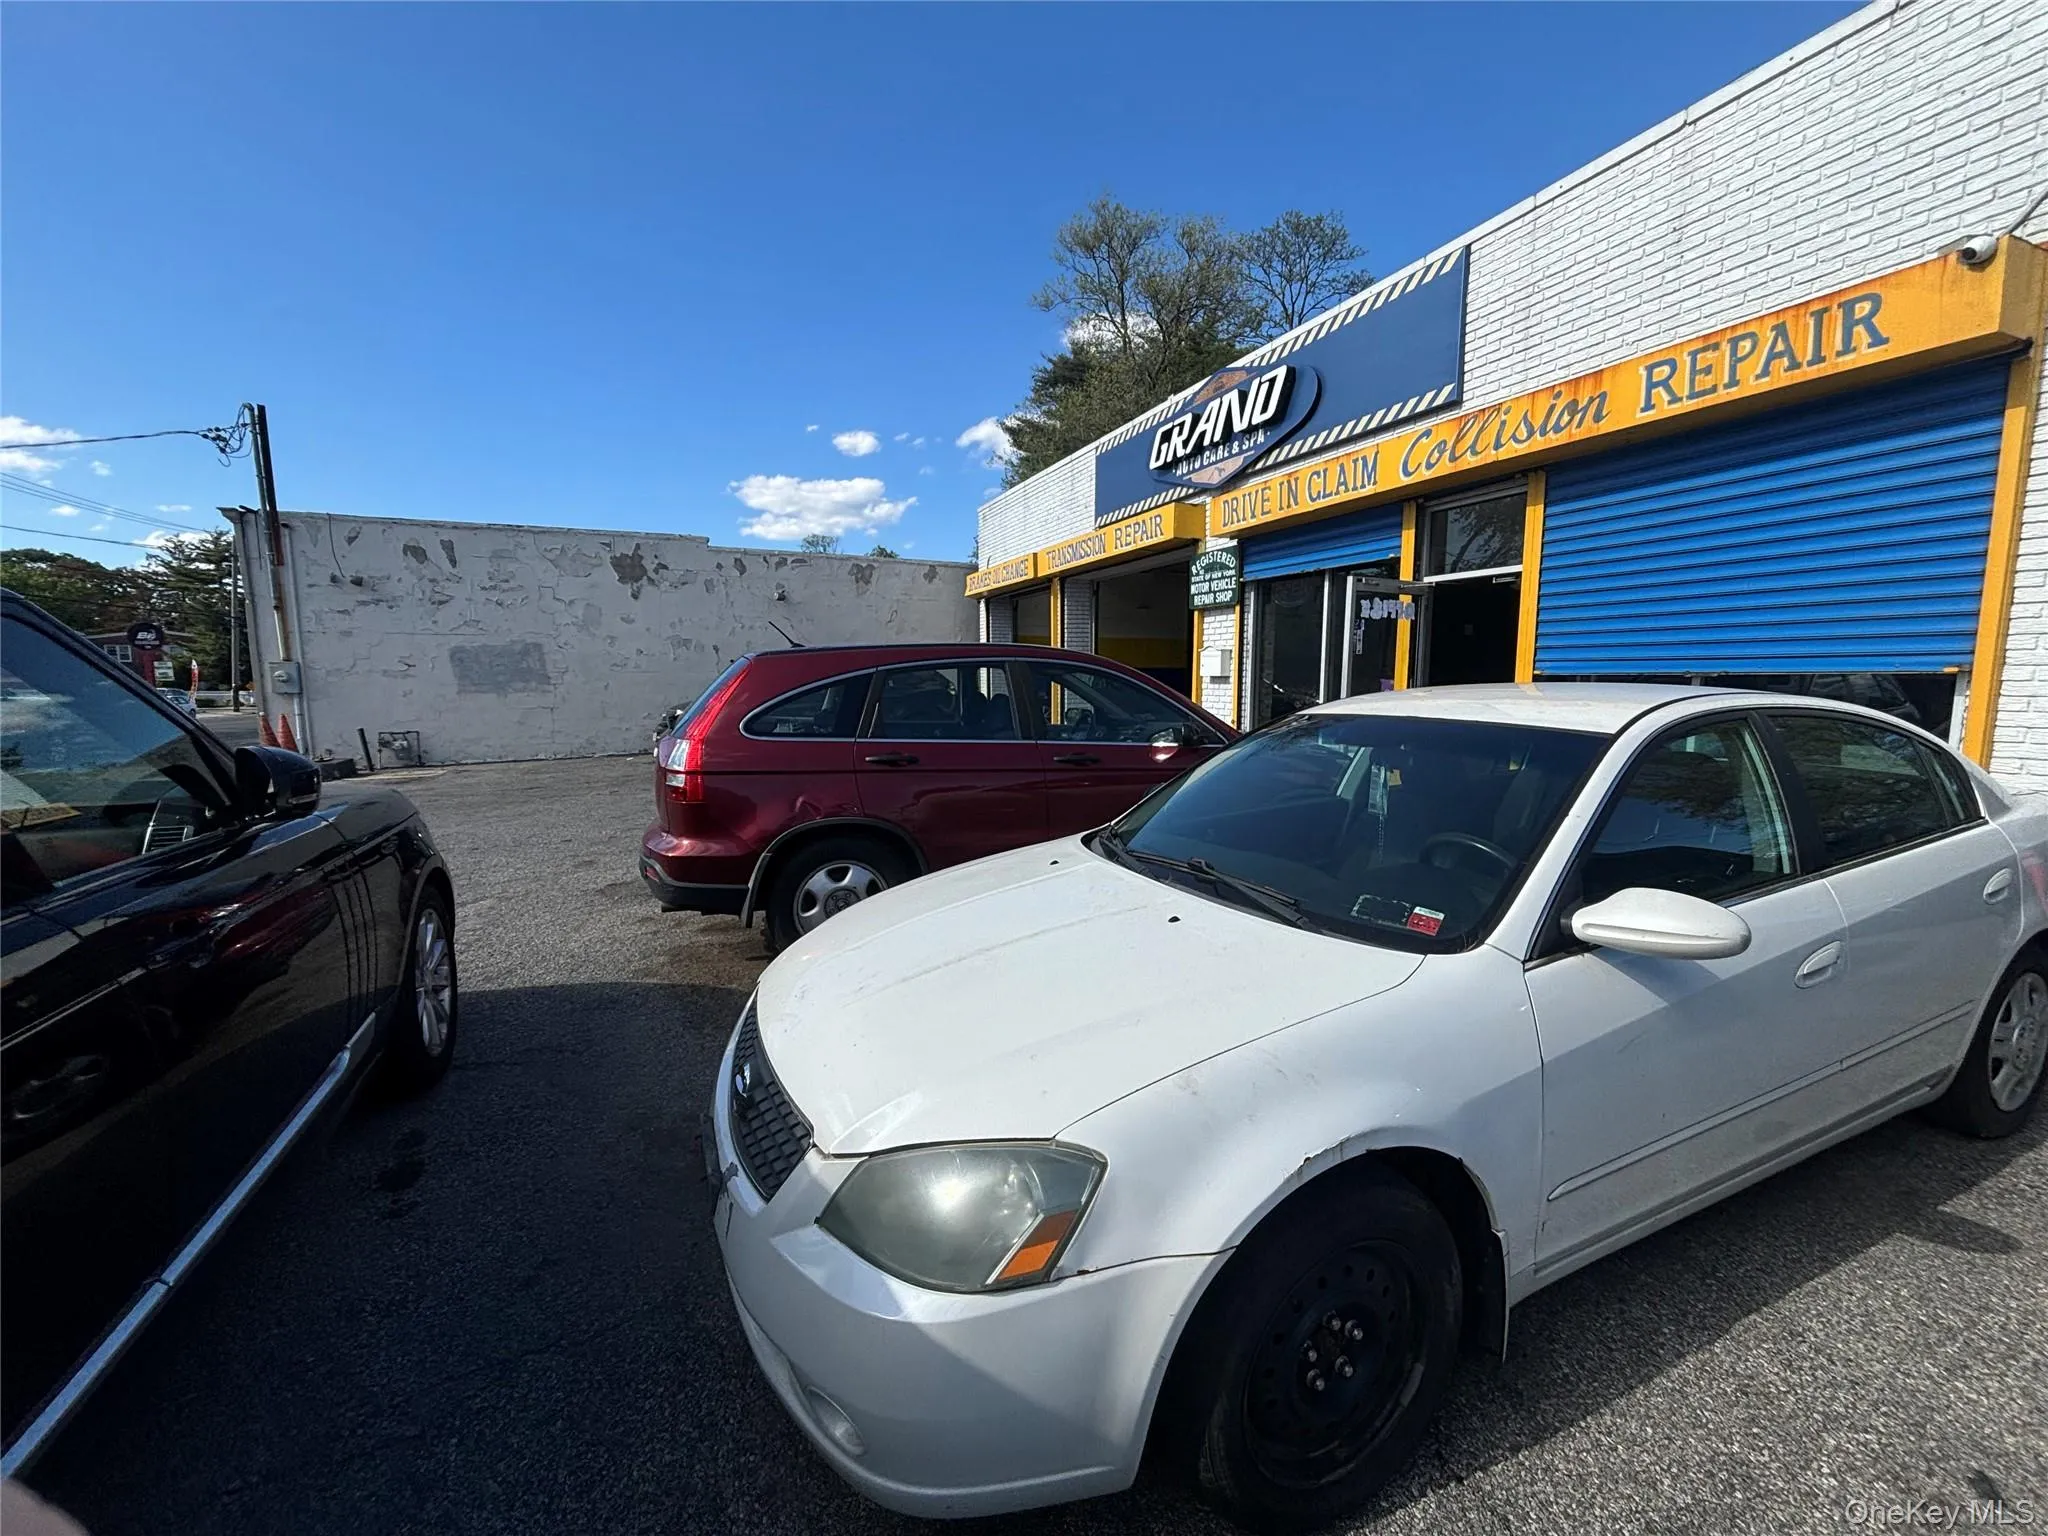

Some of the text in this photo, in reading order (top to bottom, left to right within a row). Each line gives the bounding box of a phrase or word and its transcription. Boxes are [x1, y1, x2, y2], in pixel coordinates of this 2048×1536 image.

[1149, 364, 1288, 470] GRAND
[1222, 291, 1890, 528] DRIVE IN CLAIM Collision REPAIR
[1176, 429, 1265, 477] AUTO CARE & SPA
[1046, 514, 1164, 570] TRANSMISSION REPAIR
[968, 570, 992, 592] BRAKES
[1002, 558, 1029, 582] CHANGE
[1191, 551, 1236, 576] REGISTERED
[1191, 575, 1204, 583] STATE
[1204, 572, 1211, 581] OF
[1211, 571, 1222, 579] NEW
[1222, 568, 1236, 577] YORK
[1190, 577, 1237, 595] MOTOR VEHICLE
[1193, 590, 1233, 606] REPAIR SHOP
